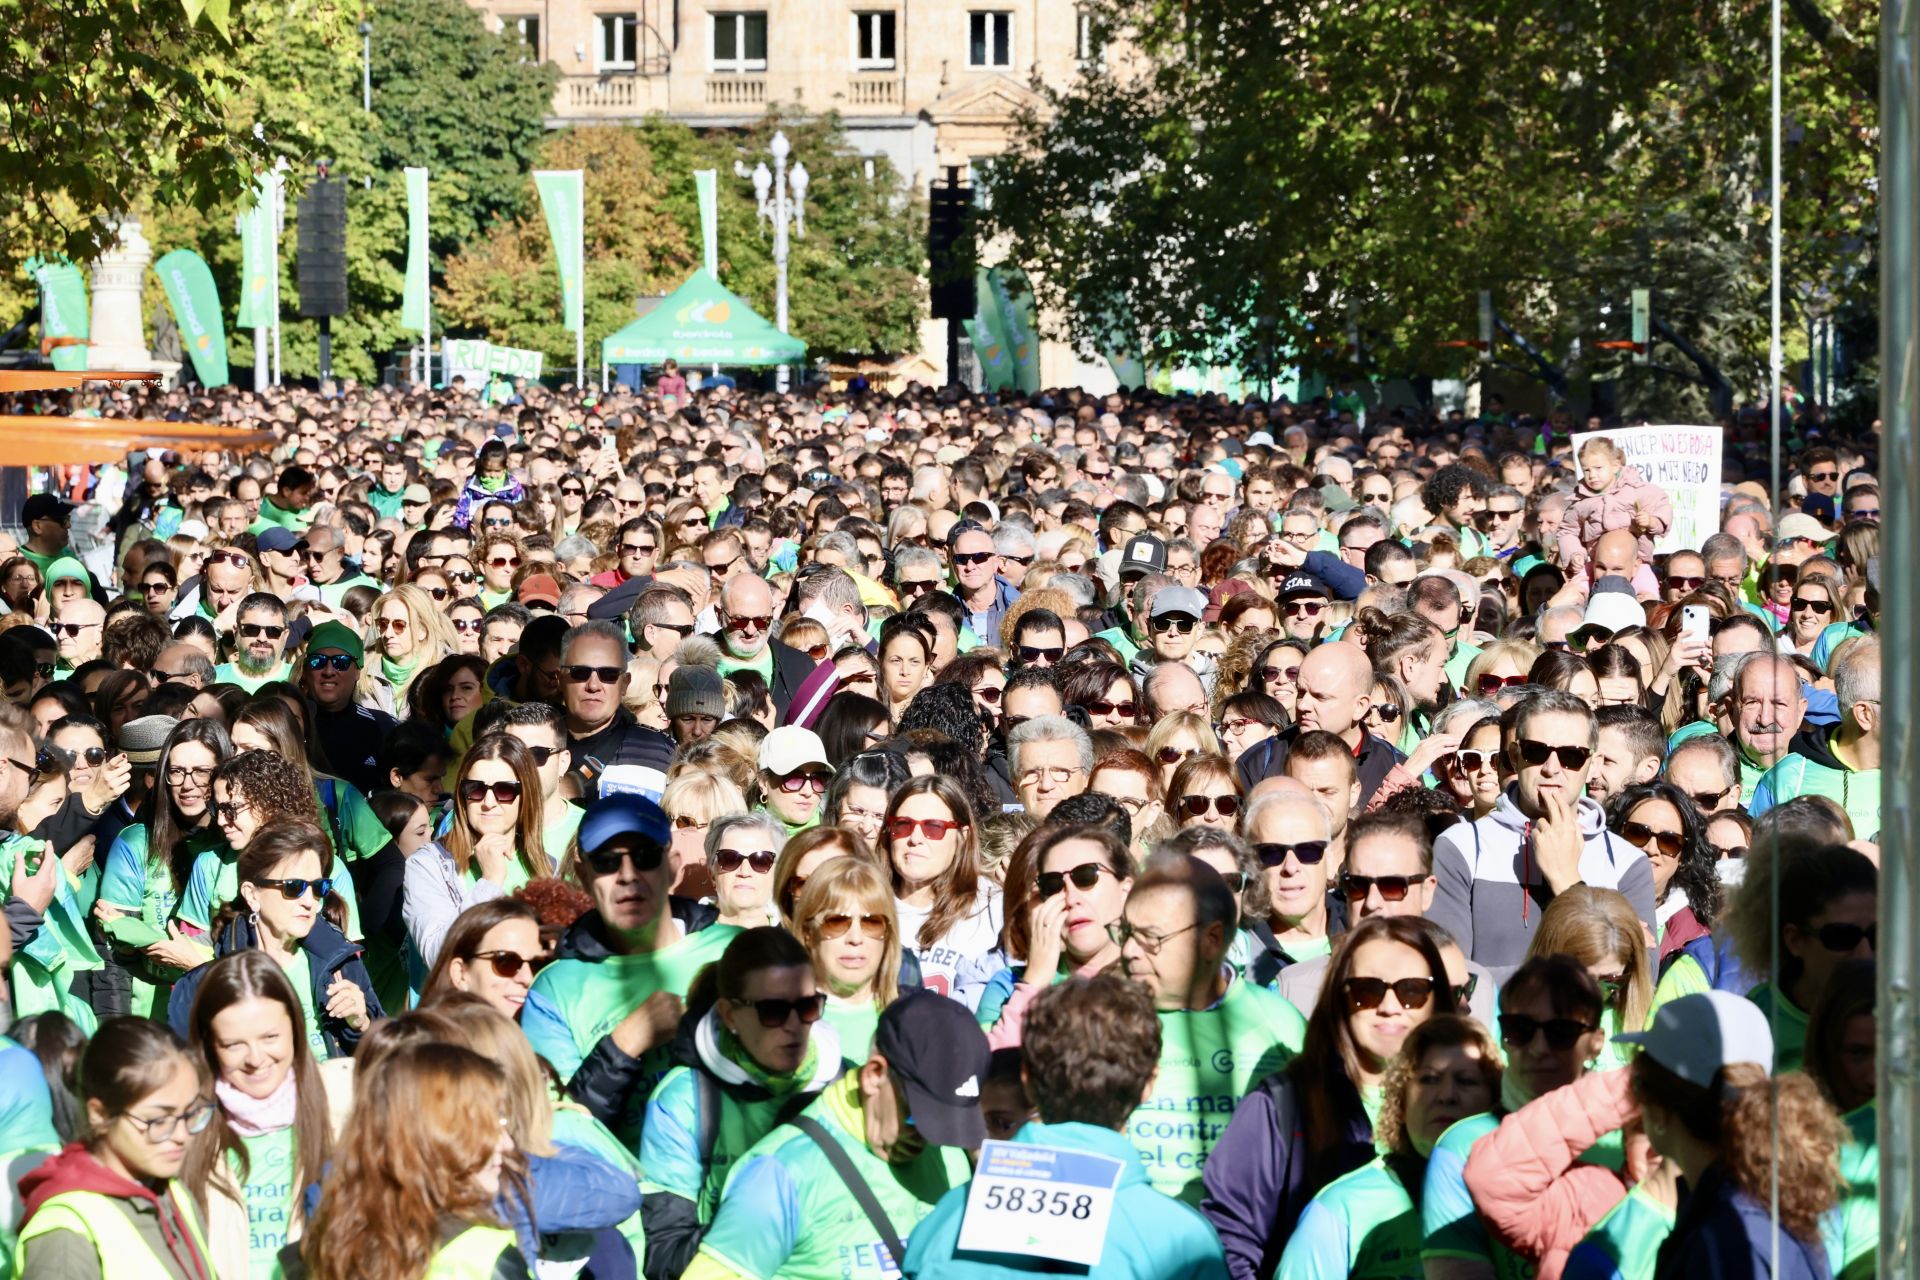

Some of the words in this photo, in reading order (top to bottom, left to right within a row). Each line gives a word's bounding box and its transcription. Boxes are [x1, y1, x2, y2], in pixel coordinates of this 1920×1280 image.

[455, 339, 538, 376] RUEDA
[1616, 433, 1657, 457] ANCER
[1285, 577, 1312, 590] STAR
[155, 894, 165, 927] ADOLID
[1135, 1119, 1231, 1141] contr
[247, 1204, 284, 1223] tra
[985, 1185, 1093, 1220] 58358
